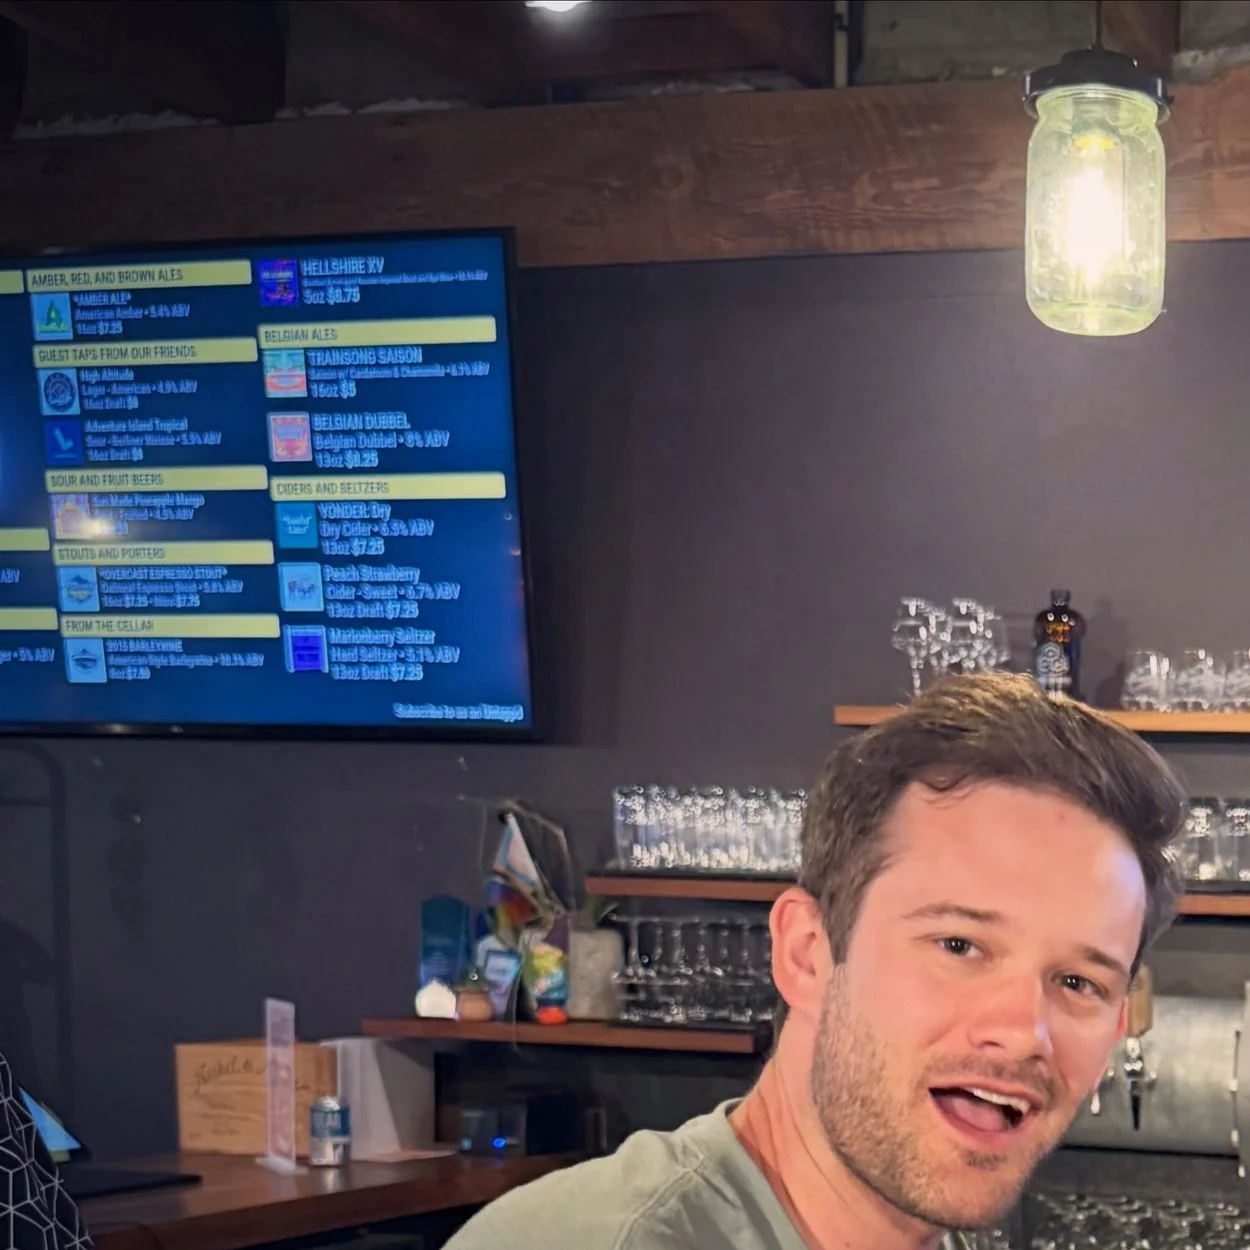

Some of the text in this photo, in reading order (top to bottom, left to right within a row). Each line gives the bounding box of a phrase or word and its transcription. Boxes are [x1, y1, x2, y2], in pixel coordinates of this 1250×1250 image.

[301, 258, 365, 275] HELLSHIRE
[367, 256, 385, 274] XV
[32, 269, 183, 287] AMBER, RED, AND BROWN ALES
[265, 328, 337, 343] BELGIAN ALES
[38, 345, 197, 362] GUEST TAPS FROM OUR FRIENDS
[377, 347, 422, 364] SAISON
[312, 411, 410, 430] BELGIAN DUBBEL
[313, 433, 356, 452] Belgian
[357, 432, 397, 448] Dubbel
[425, 430, 450, 447] ABV
[51, 473, 163, 487] SOUR AND FRUIT BEERS
[277, 482, 390, 495] CIDERS AND SELTZERS
[409, 518, 434, 536] ABV
[59, 547, 165, 560] STOUTS AND PORTERS
[435, 582, 461, 600] ABV
[66, 620, 154, 632] FROM THE CELLAR
[435, 647, 460, 663] ABV
